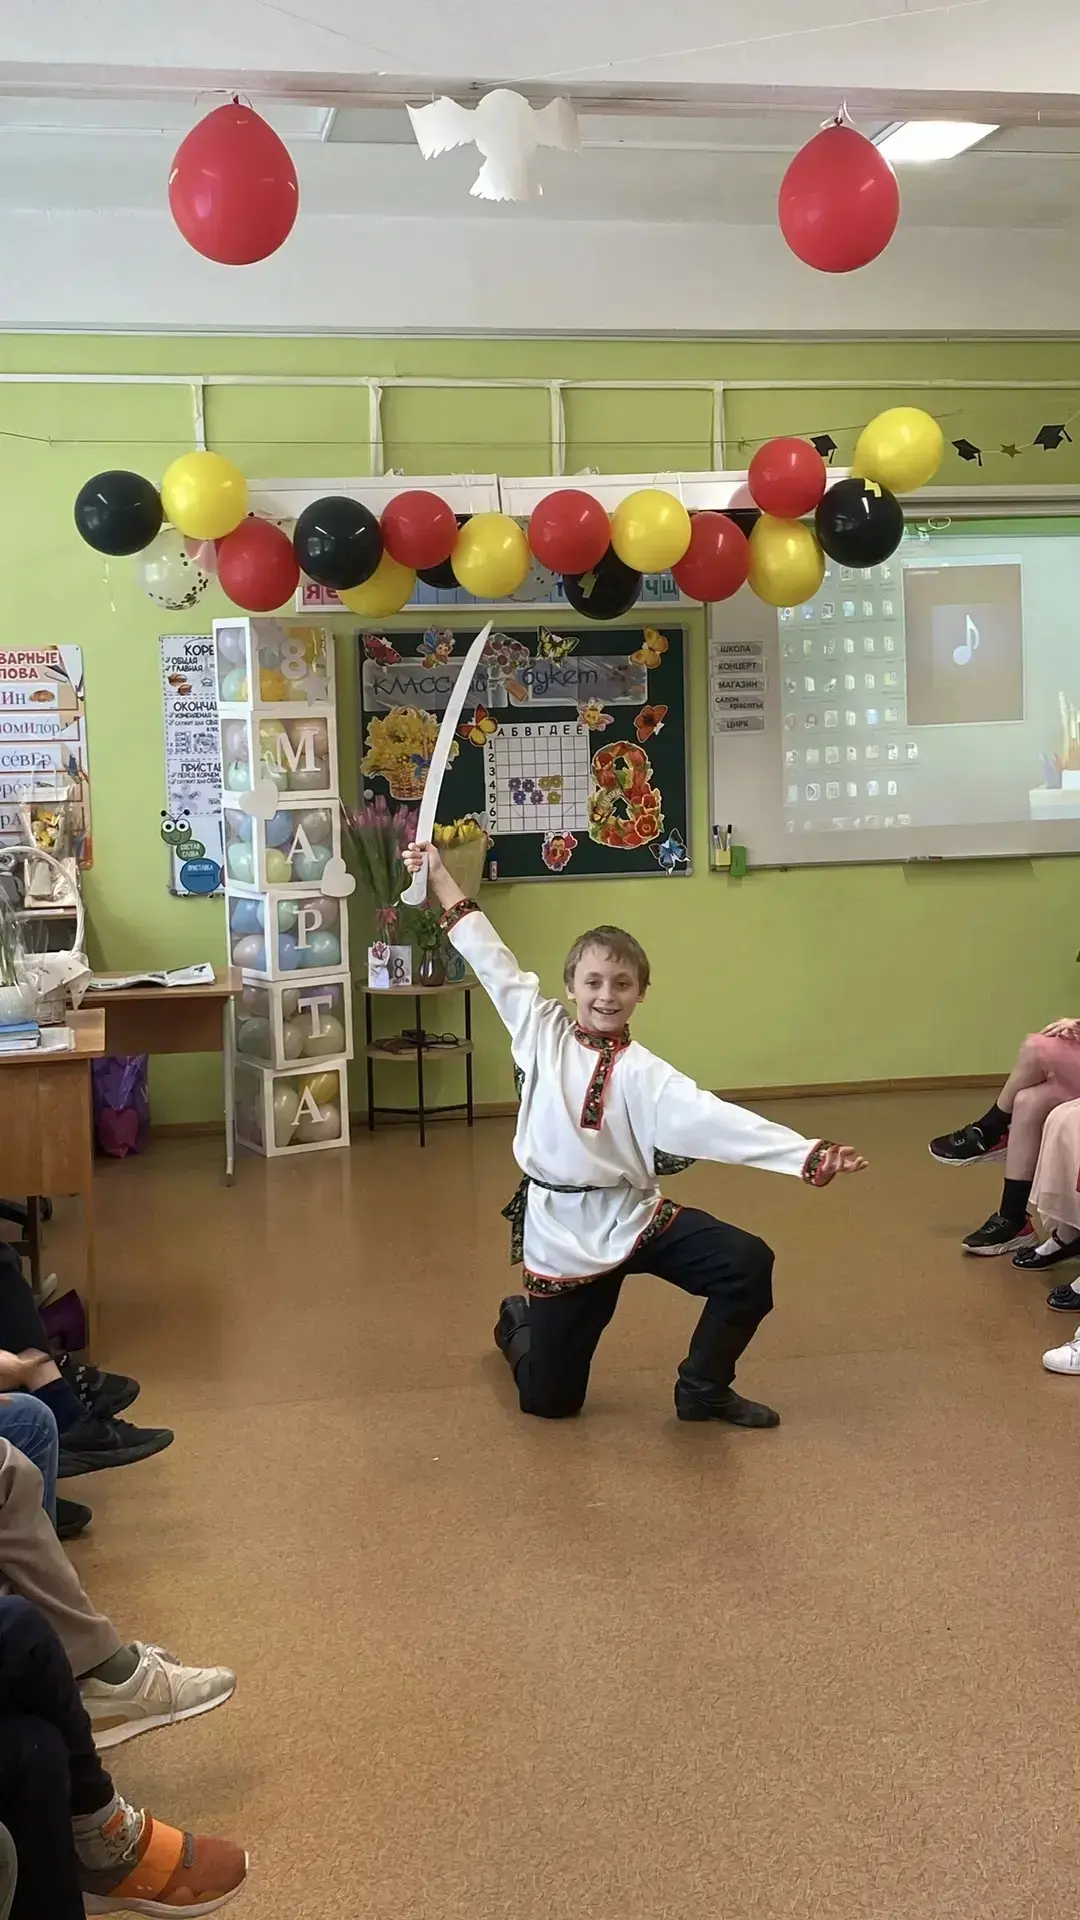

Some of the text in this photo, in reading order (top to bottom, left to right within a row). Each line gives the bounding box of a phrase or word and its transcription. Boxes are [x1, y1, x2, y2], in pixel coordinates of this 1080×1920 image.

[720, 645, 752, 653] ШКОЛА
[280, 640, 308, 680] 8
[718, 662, 757, 671] КОНЦЕРТ
[718, 681, 758, 689] МАГАЗИН
[726, 720, 749, 729] ЦИРК
[497, 728, 505, 736] А
[512, 727, 519, 736] Б
[525, 727, 532, 736] В
[538, 726, 545, 735] Г
[549, 725, 558, 736] Д
[563, 725, 571, 735] Е
[488, 754, 495, 763] 2
[489, 767, 496, 776] 3
[489, 781, 496, 789] 4
[489, 795, 497, 803] 5
[489, 807, 497, 817] 6
[490, 820, 497, 830] 7
[394, 958, 405, 979] 8
